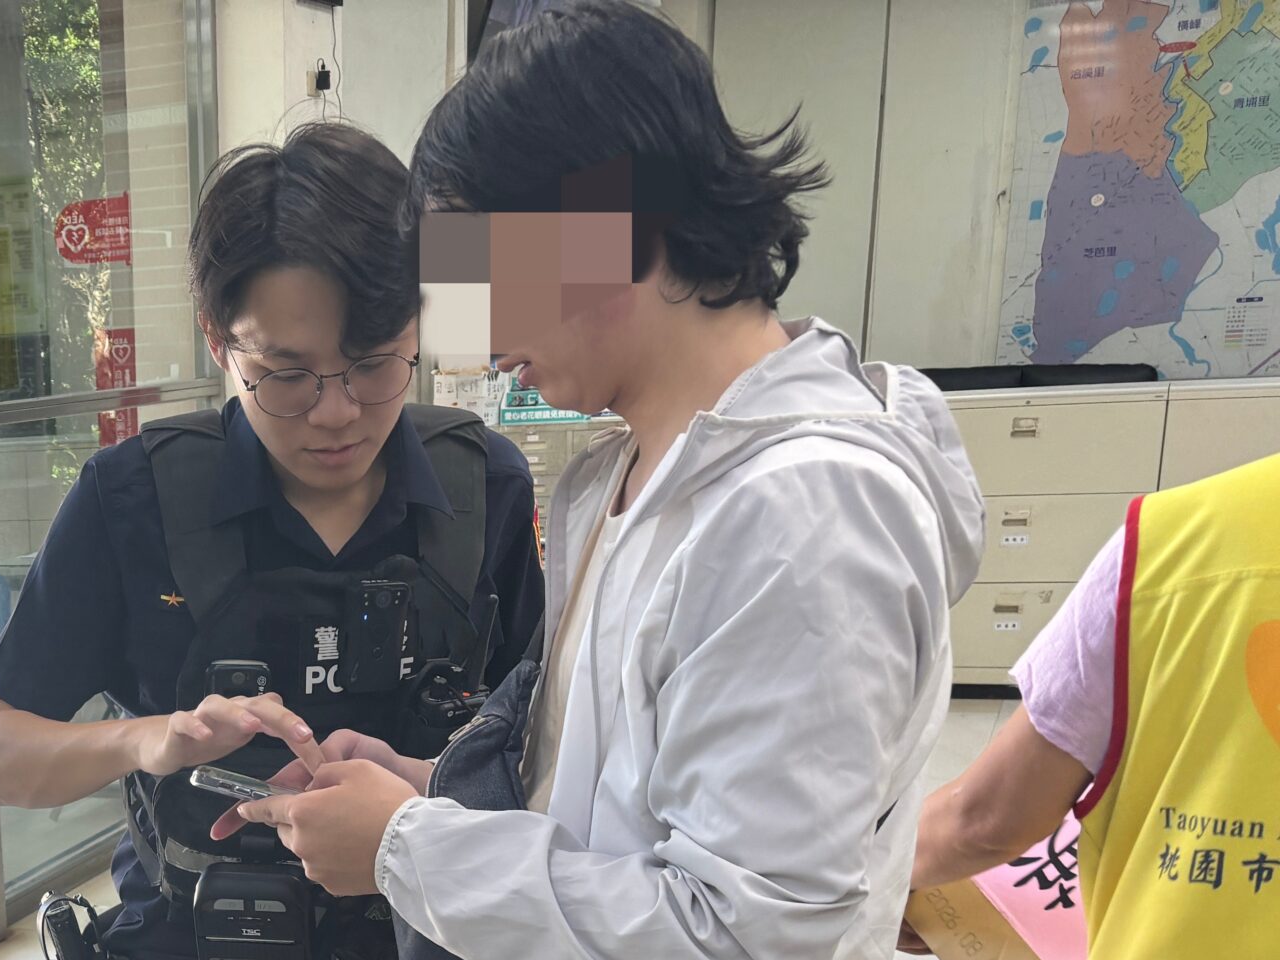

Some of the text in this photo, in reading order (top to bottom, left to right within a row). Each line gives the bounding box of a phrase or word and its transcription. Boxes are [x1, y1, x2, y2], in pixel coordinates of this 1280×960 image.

[1233, 95, 1270, 109] 青埔里
[305, 656, 416, 695] POE
[1160, 807, 1265, 839] Taoyuan
[1158, 842, 1280, 895] 桃園市
